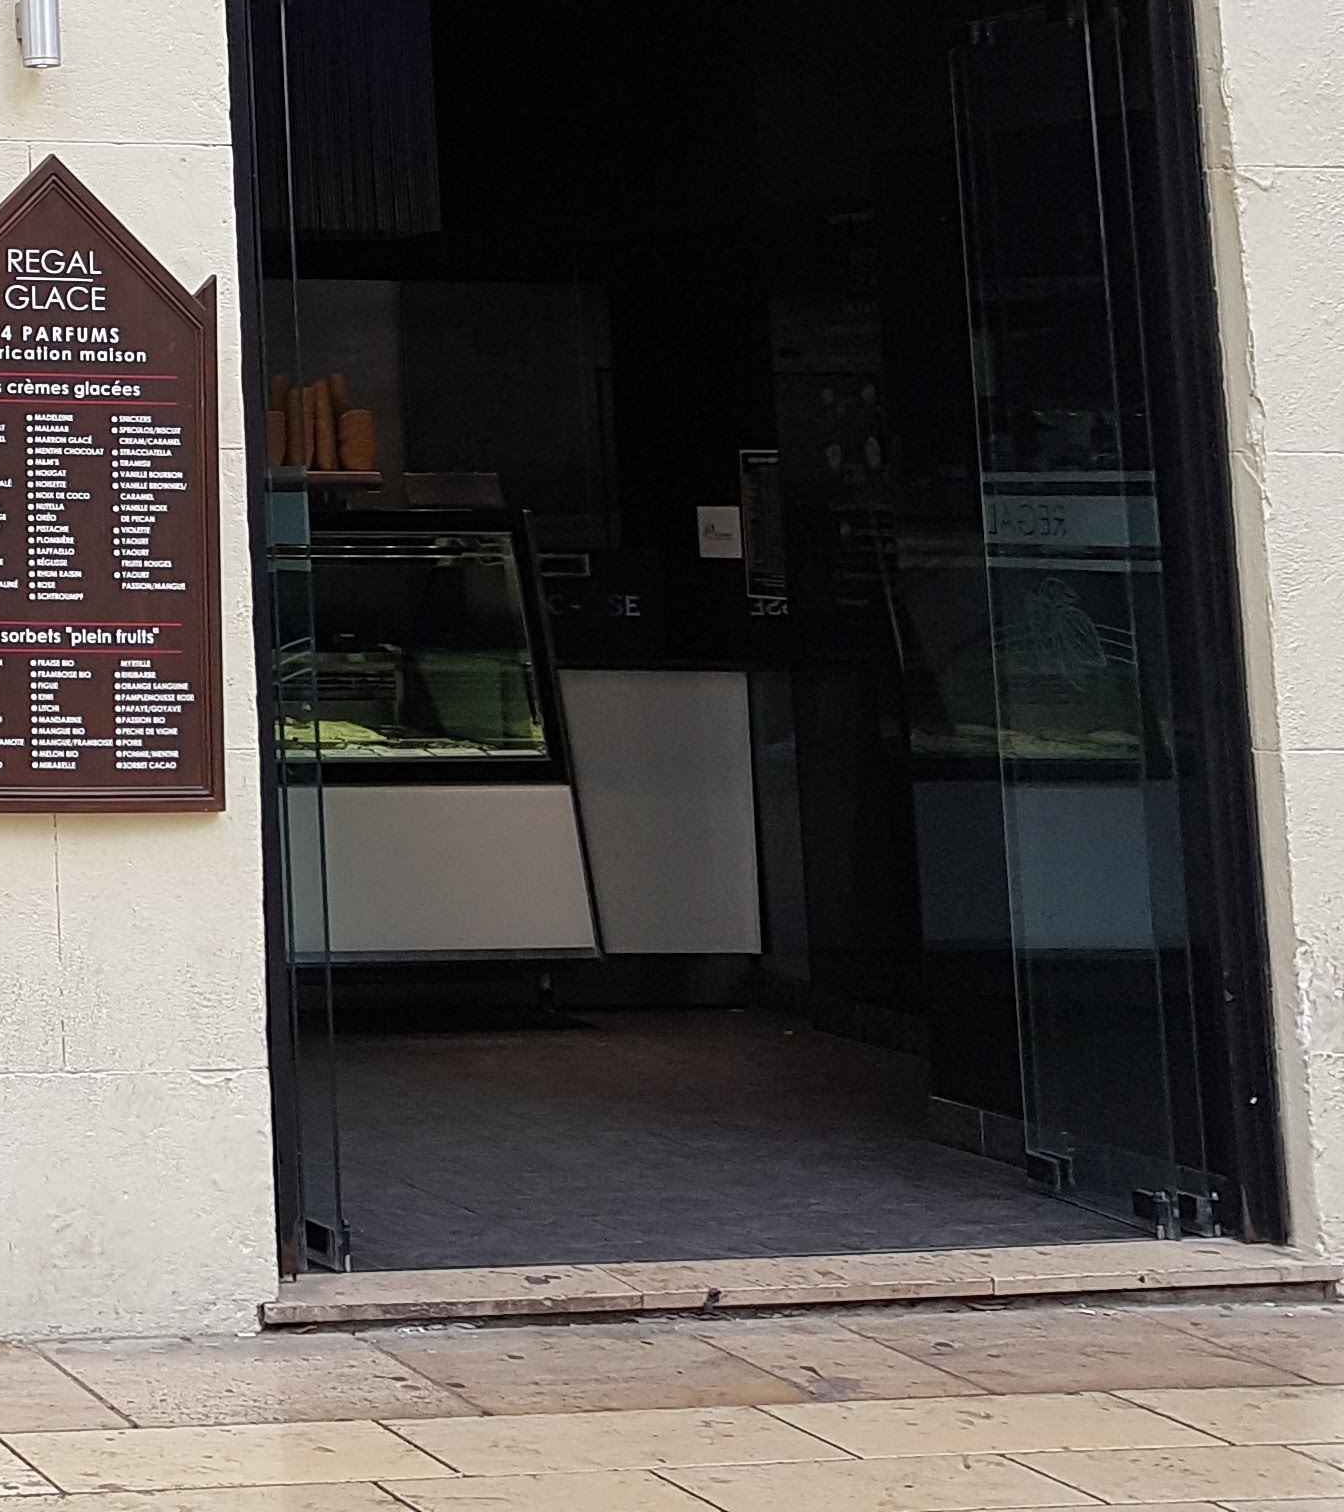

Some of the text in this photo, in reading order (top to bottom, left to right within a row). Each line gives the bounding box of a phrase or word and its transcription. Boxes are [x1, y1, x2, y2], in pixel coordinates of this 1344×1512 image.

[7, 248, 102, 275] REGAL
[4, 284, 106, 311] GLACE
[22, 325, 120, 344] PARFUMS
[79, 347, 147, 363] maison
[6, 378, 70, 395] crèmes
[73, 380, 141, 399] glacées
[0, 628, 62, 644] sorbets
